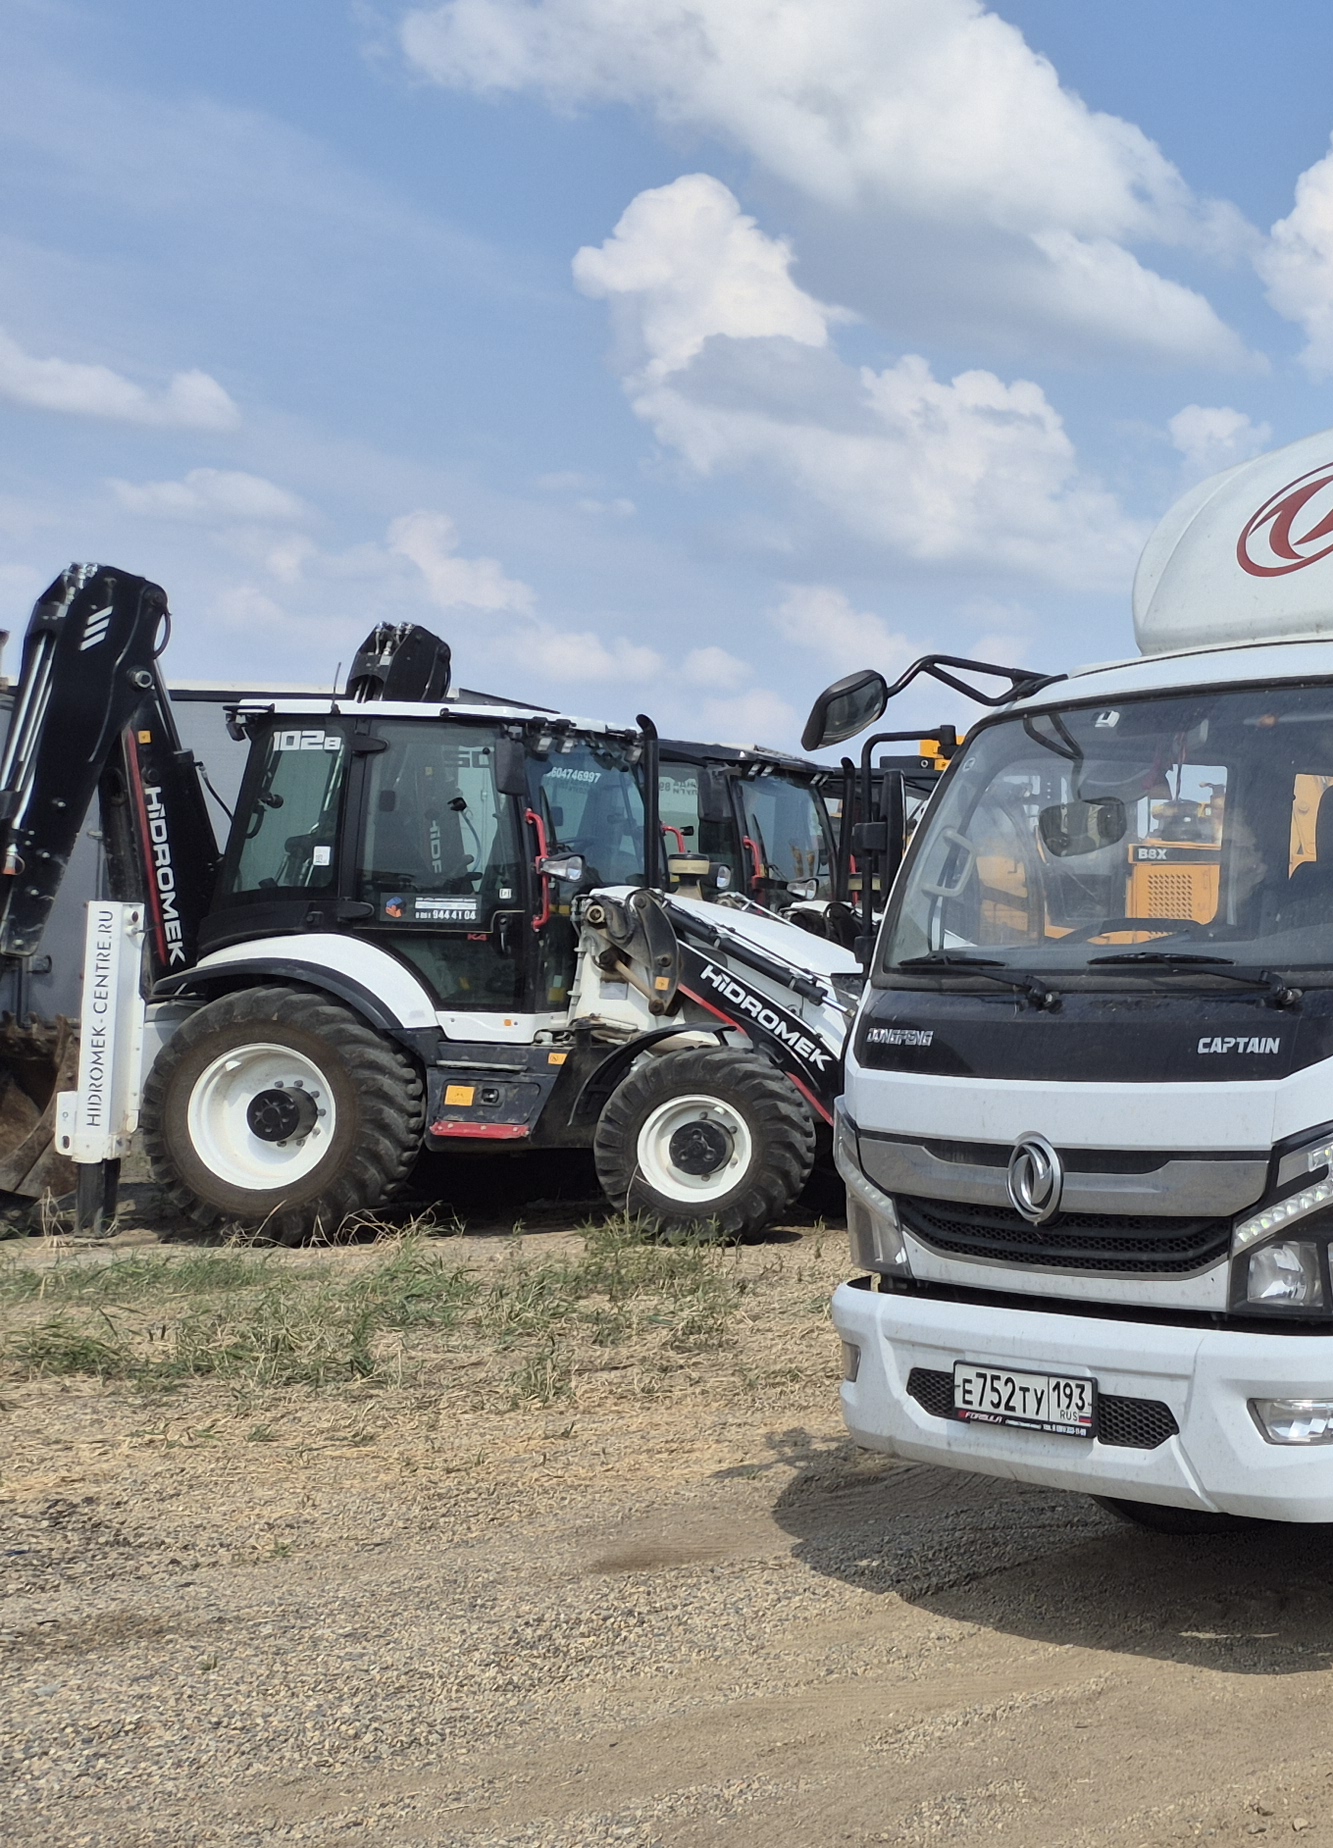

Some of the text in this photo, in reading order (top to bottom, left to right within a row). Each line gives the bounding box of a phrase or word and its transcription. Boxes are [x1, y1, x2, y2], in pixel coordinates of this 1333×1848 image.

[432, 909, 450, 920] 944
[463, 910, 477, 920] 04
[866, 1027, 934, 1046] DONGFENG
[1197, 1037, 1281, 1054] CAPTAIN
[961, 1371, 1086, 1417] Е752ТУ 193
[1059, 1409, 1079, 1422] RUS
